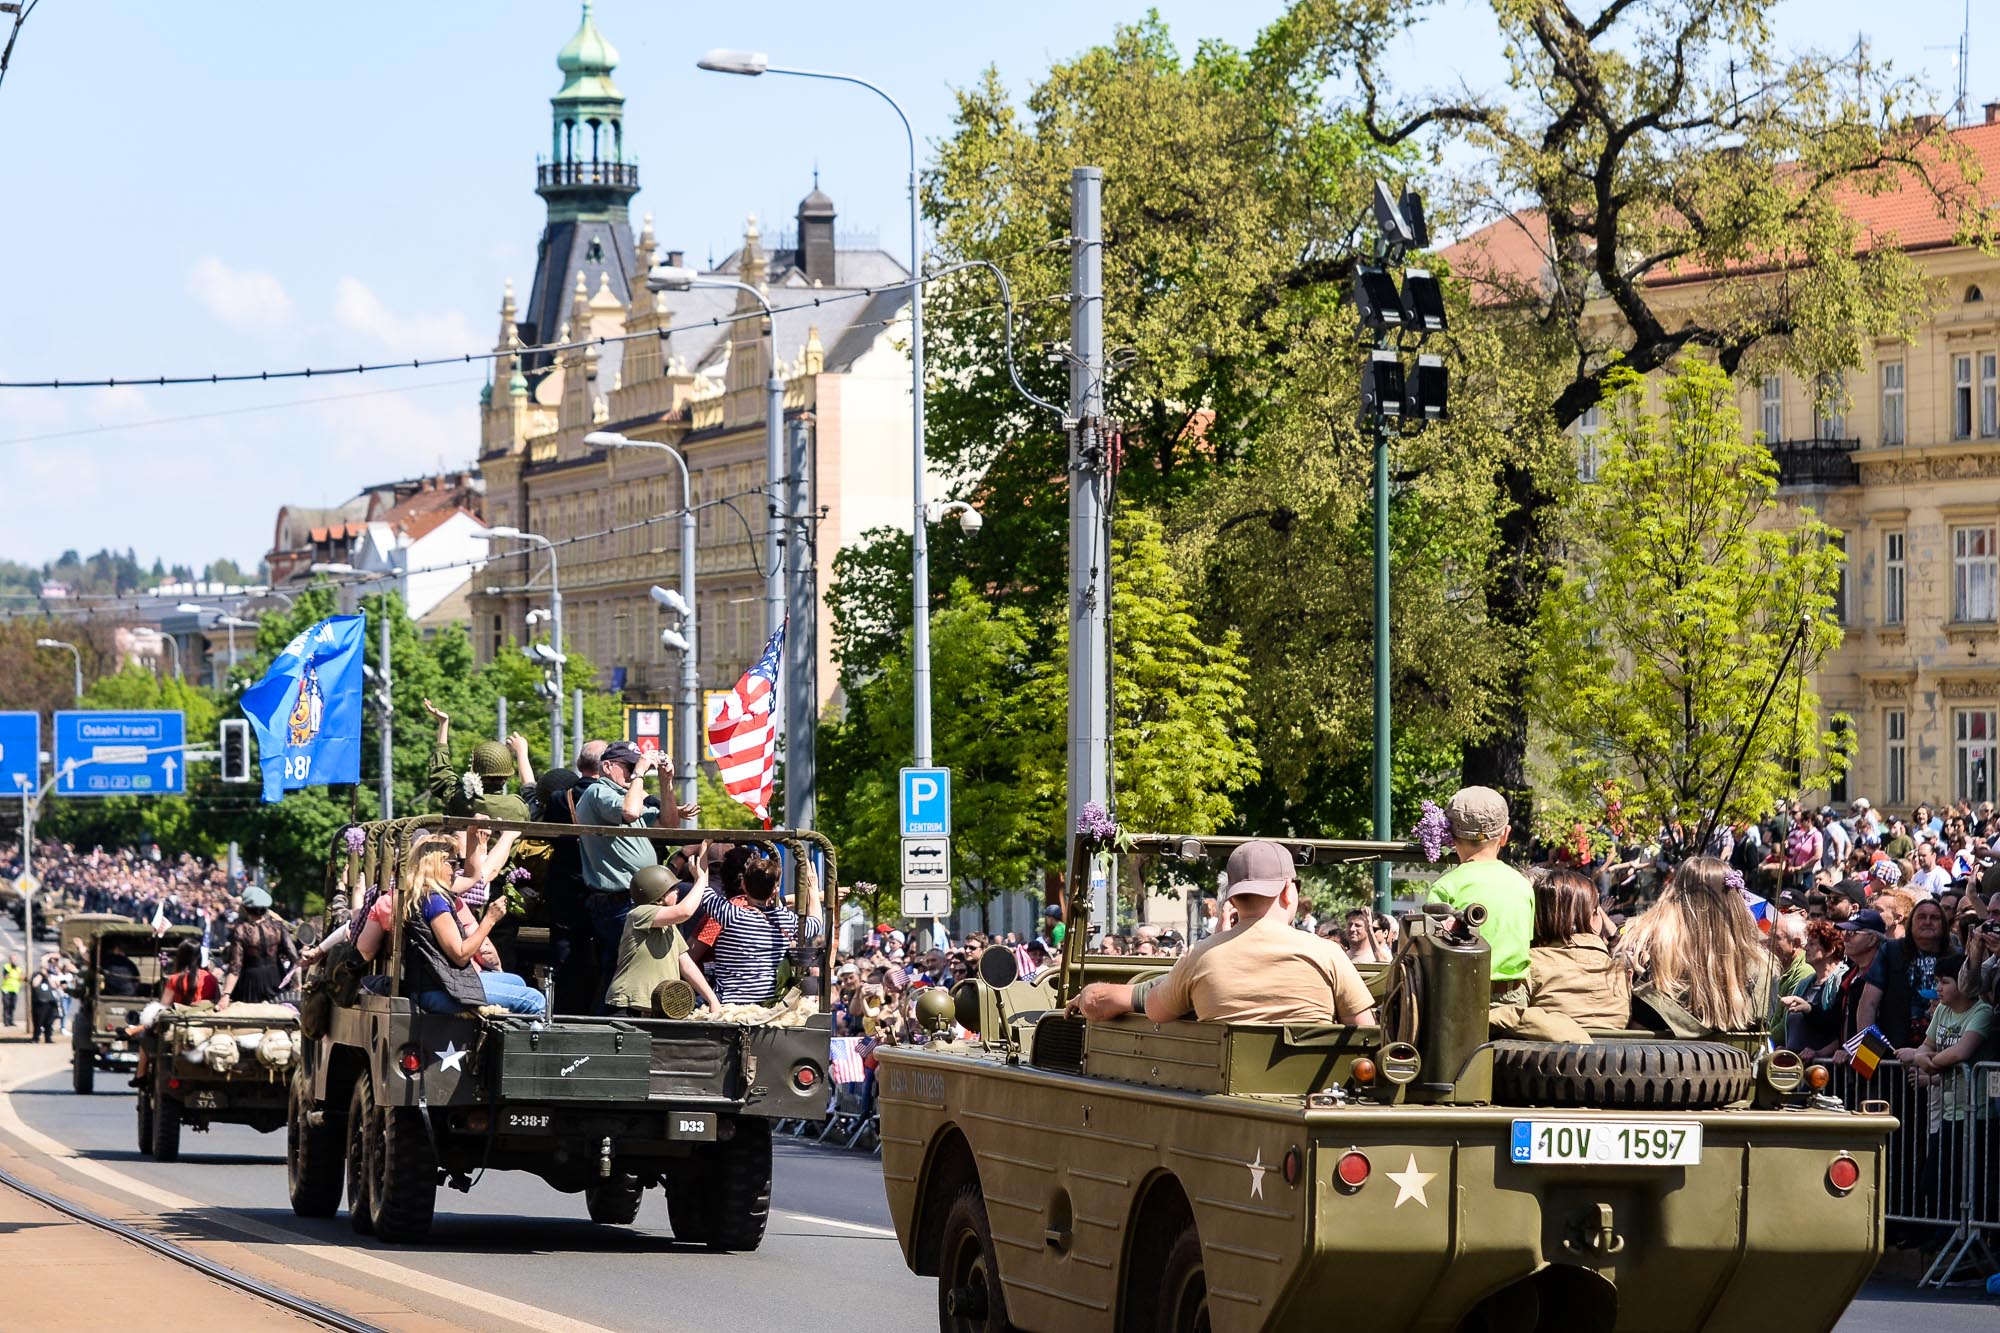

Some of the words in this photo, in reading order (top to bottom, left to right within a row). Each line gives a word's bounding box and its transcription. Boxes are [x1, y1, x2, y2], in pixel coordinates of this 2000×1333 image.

[912, 777, 938, 816] P
[910, 822, 943, 832] CENTRUM
[889, 1068, 908, 1092] USA
[509, 1114, 550, 1127] 2-38-F
[679, 1120, 705, 1132] D33
[1540, 1127, 1591, 1158] 10V
[1617, 1128, 1686, 1160] 1597
[1514, 1146, 1530, 1158] CZ
